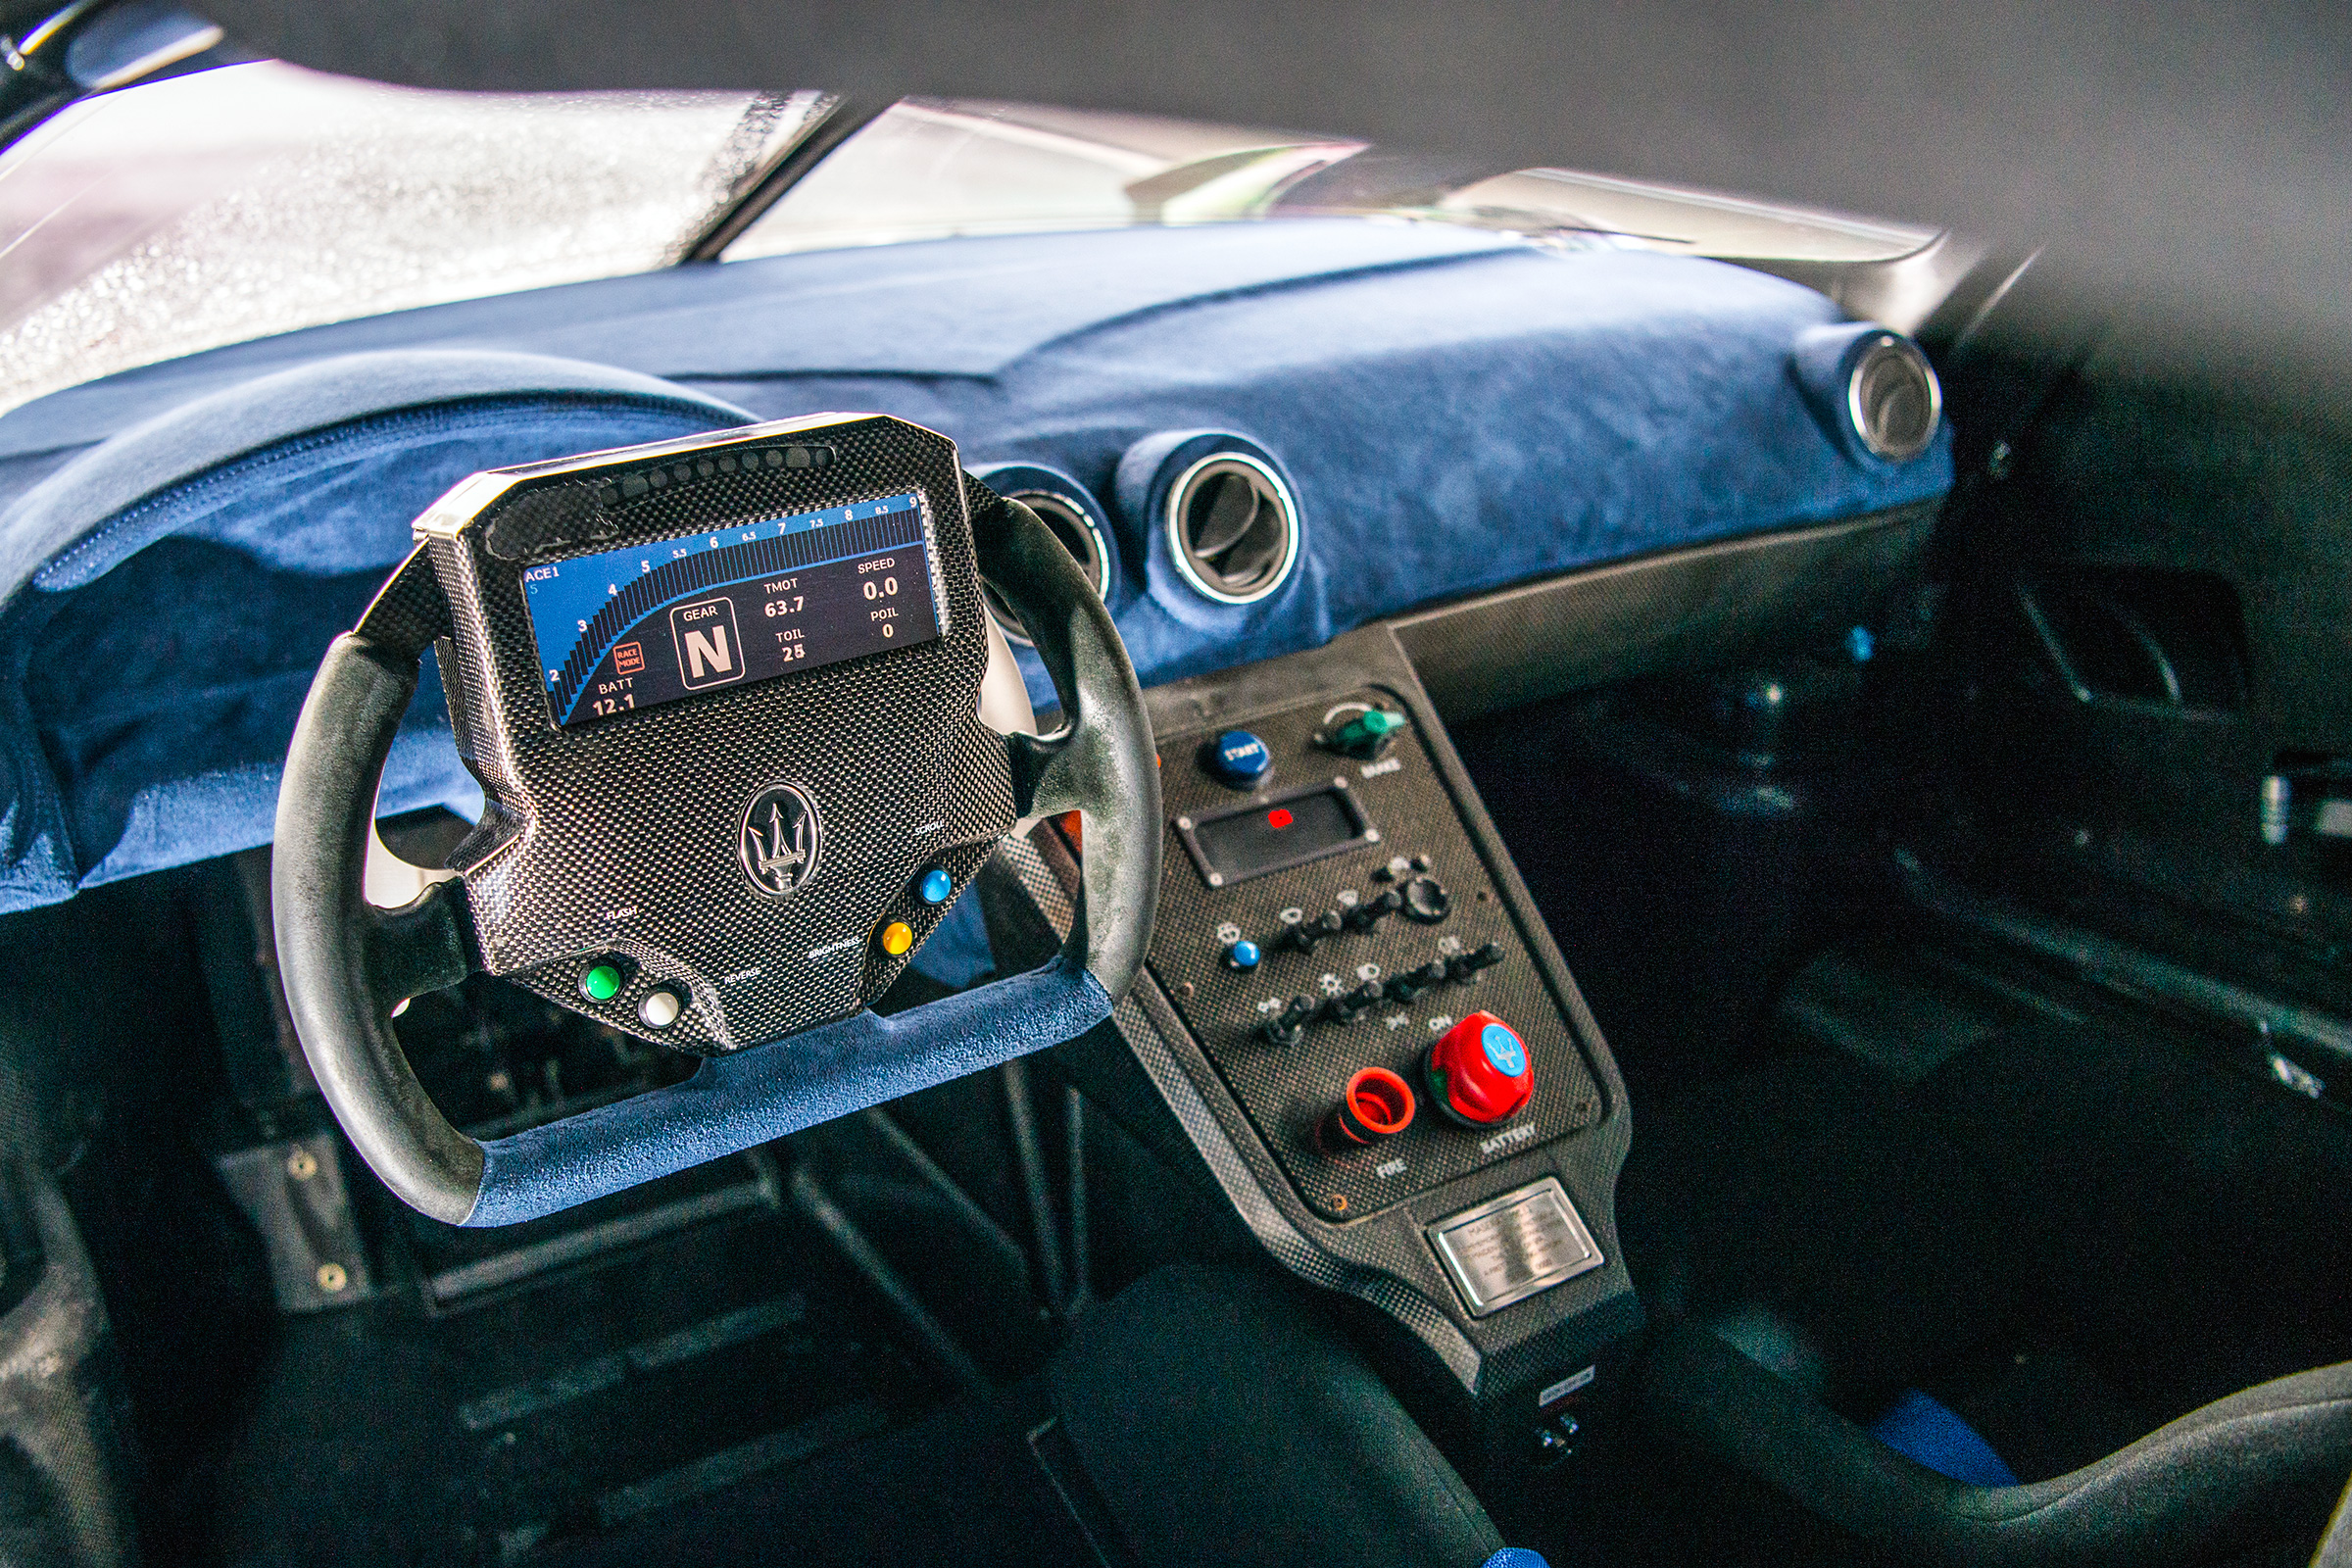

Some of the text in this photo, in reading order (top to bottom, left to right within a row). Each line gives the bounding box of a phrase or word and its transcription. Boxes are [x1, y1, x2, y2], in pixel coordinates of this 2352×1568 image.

[908, 496, 917, 508] 9
[844, 509, 854, 521] 8
[874, 505, 889, 515] 8.5
[777, 522, 787, 535] 7
[809, 518, 824, 529] 7.5
[710, 536, 718, 549] 6
[742, 531, 757, 542] 6.5
[672, 548, 687, 559] 5.5
[524, 565, 560, 582] ACE1
[641, 561, 651, 573] 5
[858, 558, 896, 574] SPEED
[529, 583, 538, 594] 5
[608, 583, 617, 595] 4
[763, 577, 799, 594] TMOT
[862, 576, 899, 601] 0.0
[683, 606, 718, 622] GEAR
[764, 596, 805, 617] 63.7
[870, 607, 900, 622] POIL
[577, 619, 588, 632] 3
[882, 623, 894, 638] 0
[775, 628, 806, 643] TOIL
[617, 648, 638, 660] RACE
[684, 624, 732, 679] N
[617, 657, 641, 668] MODE
[549, 669, 561, 682] 2
[598, 677, 633, 695] BATT
[592, 693, 635, 716] 12.1
[1224, 743, 1259, 761] START
[914, 820, 945, 836] SCROLL
[606, 906, 638, 921] FLASH
[808, 936, 860, 959] BRIGHTNESS
[724, 966, 761, 985] REVERSE
[1479, 1121, 1536, 1154] BATTERY
[1376, 1157, 1407, 1180] FIRE
